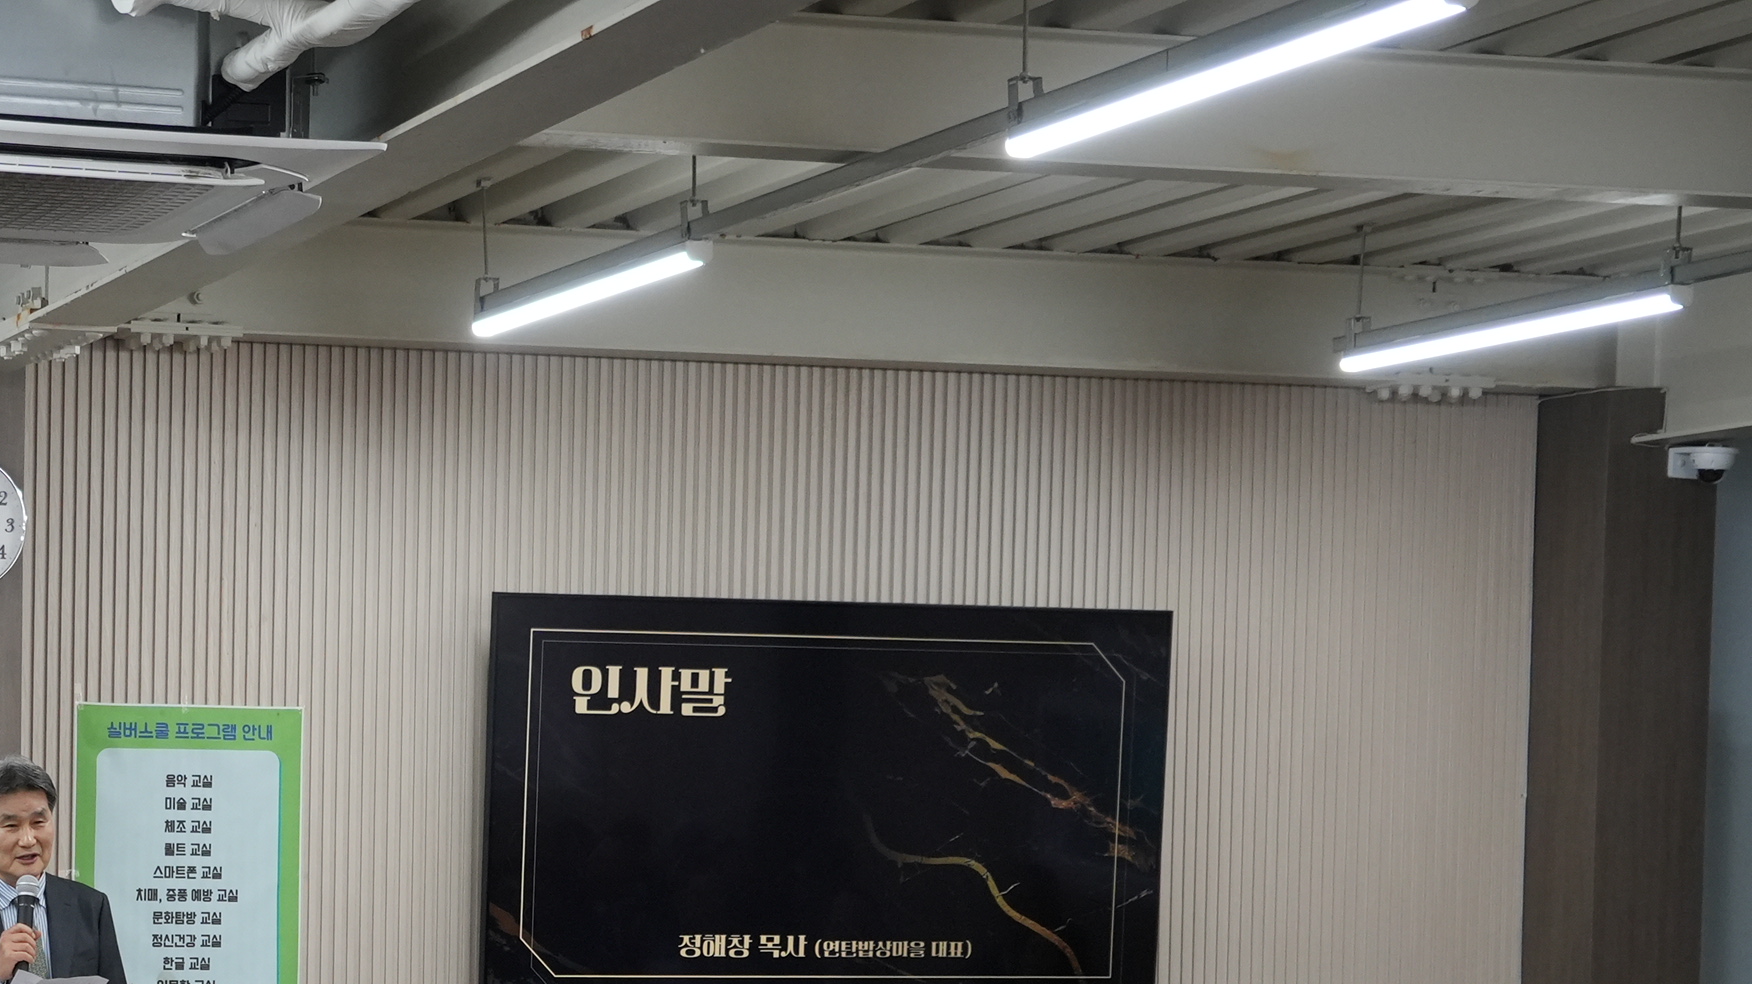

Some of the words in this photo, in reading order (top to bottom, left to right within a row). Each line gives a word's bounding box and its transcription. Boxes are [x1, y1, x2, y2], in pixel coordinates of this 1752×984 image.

[5, 518, 14, 532] 3
[570, 663, 733, 719] 인사말
[107, 721, 170, 739] 실버스쿨
[175, 722, 237, 741] 프로그램
[242, 724, 273, 741] 안내
[165, 774, 187, 788] 음악
[191, 774, 212, 788] 교실
[165, 797, 187, 810] 미술
[190, 797, 212, 811] 교실
[164, 819, 186, 833] 체조
[190, 820, 212, 834] 교실
[165, 843, 186, 856] 퀼트
[190, 843, 211, 856] 교실
[153, 866, 197, 879] 스마트폰
[201, 866, 222, 879] 교실
[136, 888, 162, 903] 치매,
[166, 889, 187, 902] 중풍
[191, 889, 213, 902] 예방
[217, 889, 238, 902] 교실
[153, 911, 197, 925] 문화탐방
[200, 912, 222, 925] 교실
[152, 934, 197, 947] 정신건강
[200, 934, 222, 948] 교실
[678, 934, 753, 958] 정해창
[758, 934, 807, 958] 목사
[814, 939, 925, 958] (연탄밥상마을
[931, 940, 972, 959] 대표)
[163, 957, 184, 970] 한글
[189, 957, 210, 970] 교실
